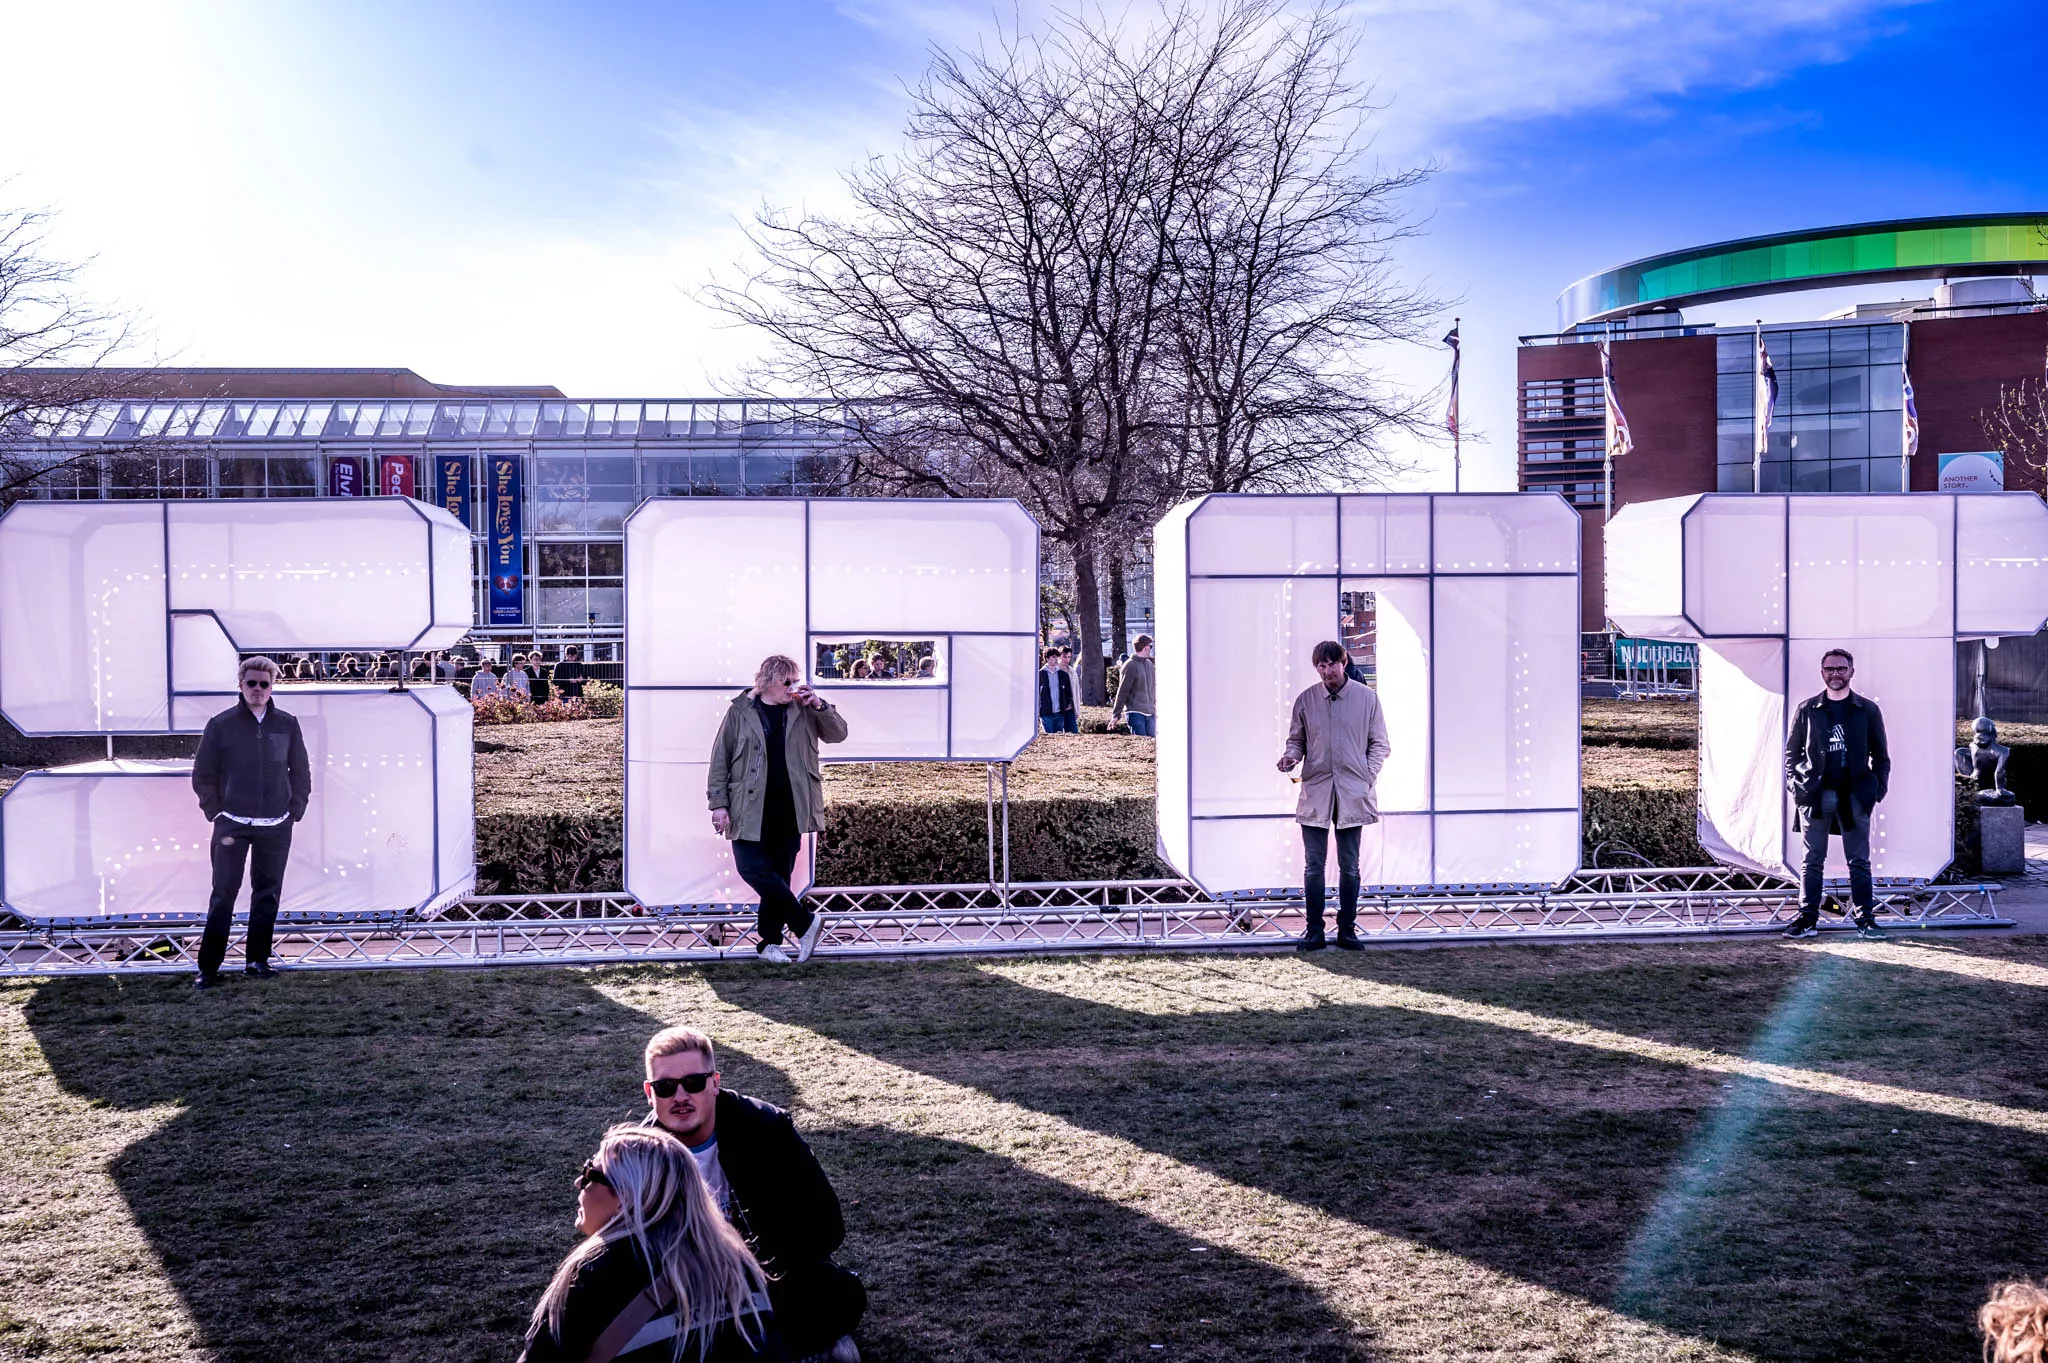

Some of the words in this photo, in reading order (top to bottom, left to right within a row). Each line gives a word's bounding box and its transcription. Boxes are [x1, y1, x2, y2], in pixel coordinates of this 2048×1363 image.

[444, 461, 462, 494] She
[496, 461, 513, 494] She
[498, 533, 514, 565] You
